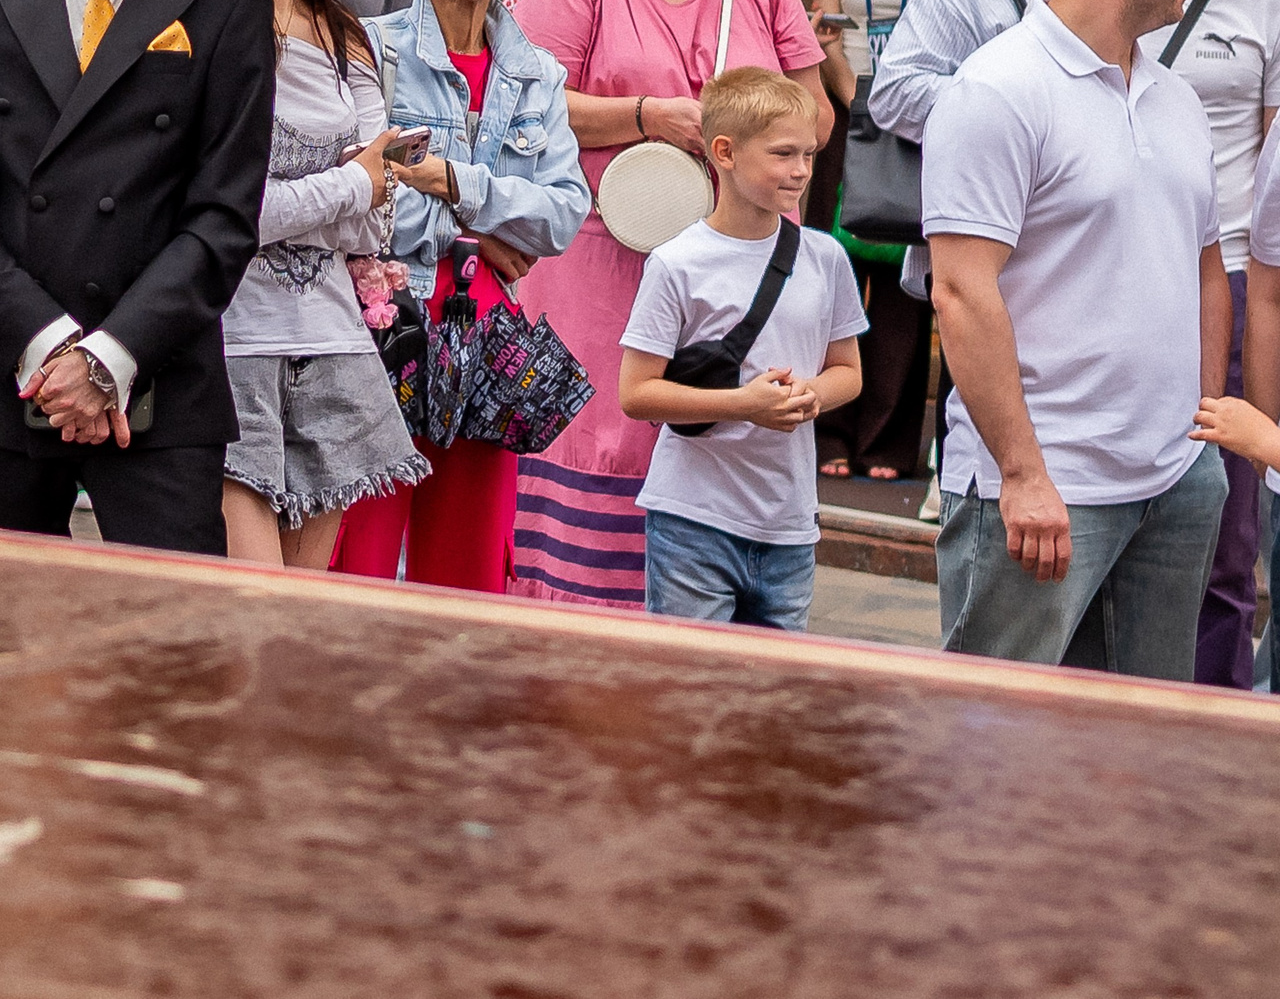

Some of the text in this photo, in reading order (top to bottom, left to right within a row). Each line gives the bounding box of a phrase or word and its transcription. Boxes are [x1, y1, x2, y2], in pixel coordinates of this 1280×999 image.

[1196, 51, 1230, 60] PUMA
[491, 342, 518, 373] YORK
[503, 348, 528, 378] NEW
[520, 367, 537, 388] NY
